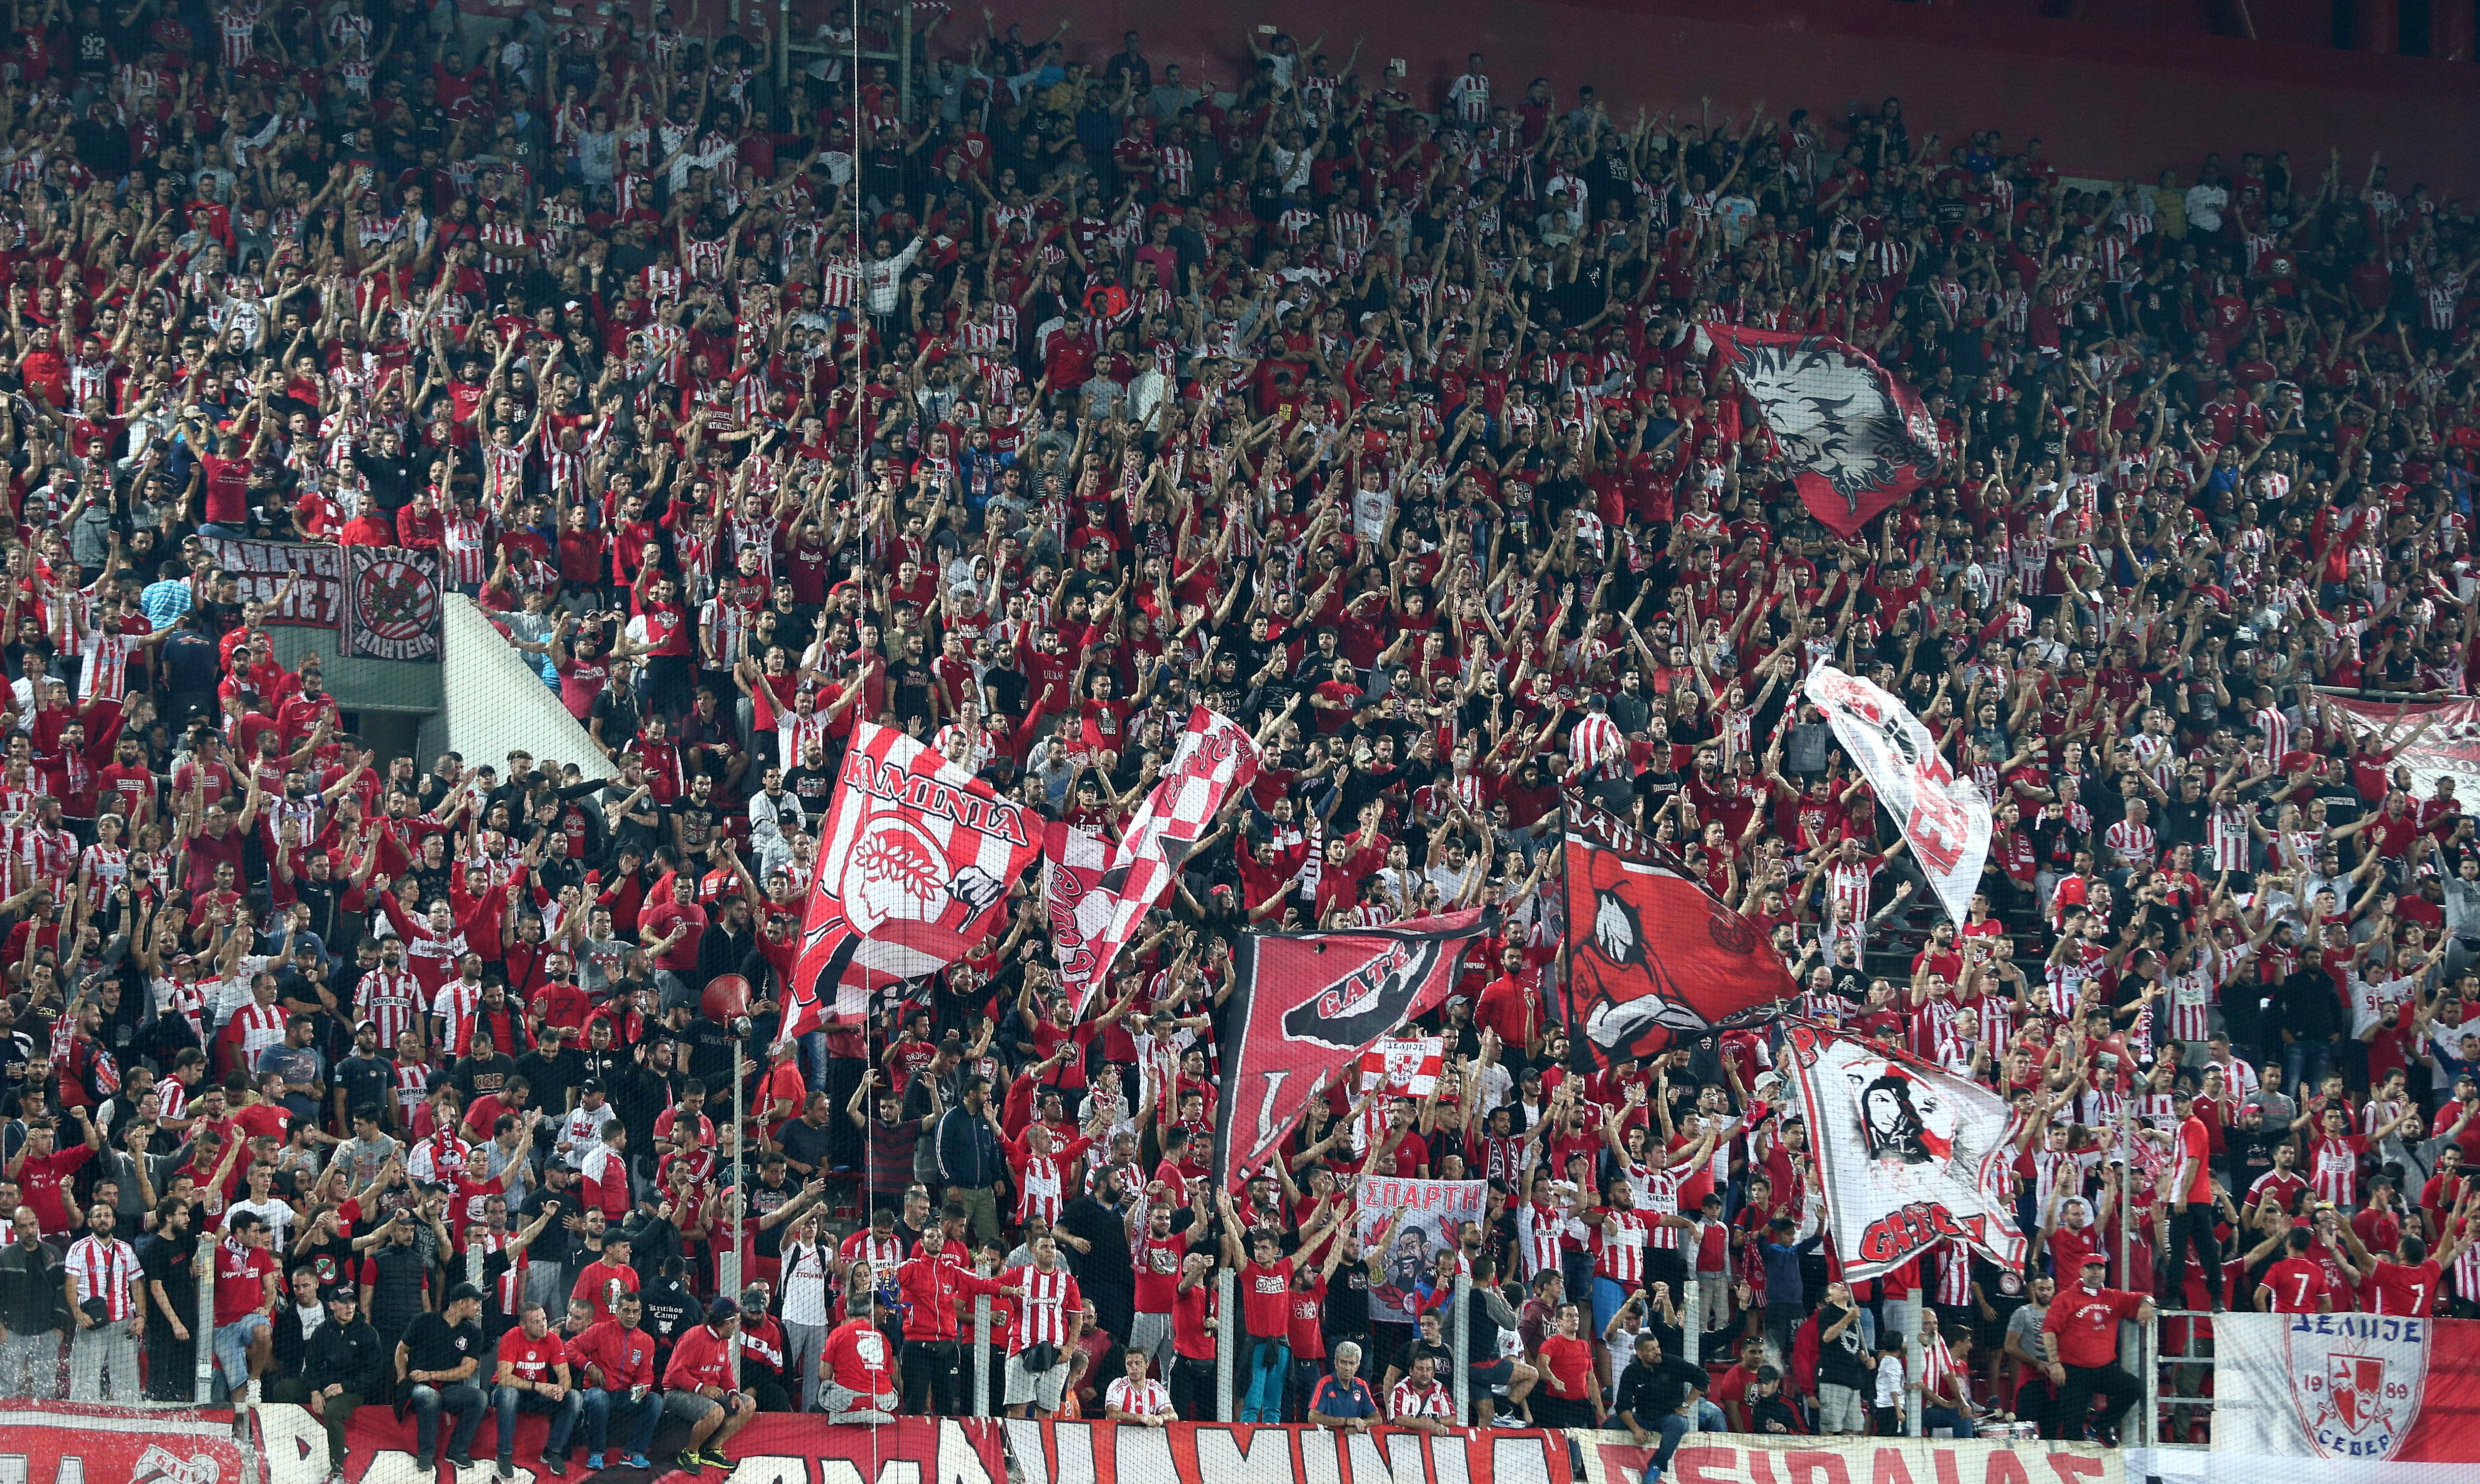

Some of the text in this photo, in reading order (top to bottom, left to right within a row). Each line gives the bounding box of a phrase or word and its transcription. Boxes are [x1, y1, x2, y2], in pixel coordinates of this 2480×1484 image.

[843, 748, 1030, 847] KAMINIA
[1074, 822, 1104, 835] LEGEN
[1079, 814, 1086, 823] 7
[1318, 940, 1412, 1020] GATE
[554, 997, 575, 1022] 7
[1364, 1179, 1480, 1212] ΣΠΑΡΤΗ
[2293, 1272, 2309, 1306] 7
[2410, 1283, 2425, 1314] 7
[648, 1304, 684, 1313] Kritikos
[654, 1311, 678, 1320] Camp
[2304, 1374, 2324, 1392] 19
[2386, 1382, 2408, 1400] 89
[2318, 1429, 2391, 1457] СЕВЕР
